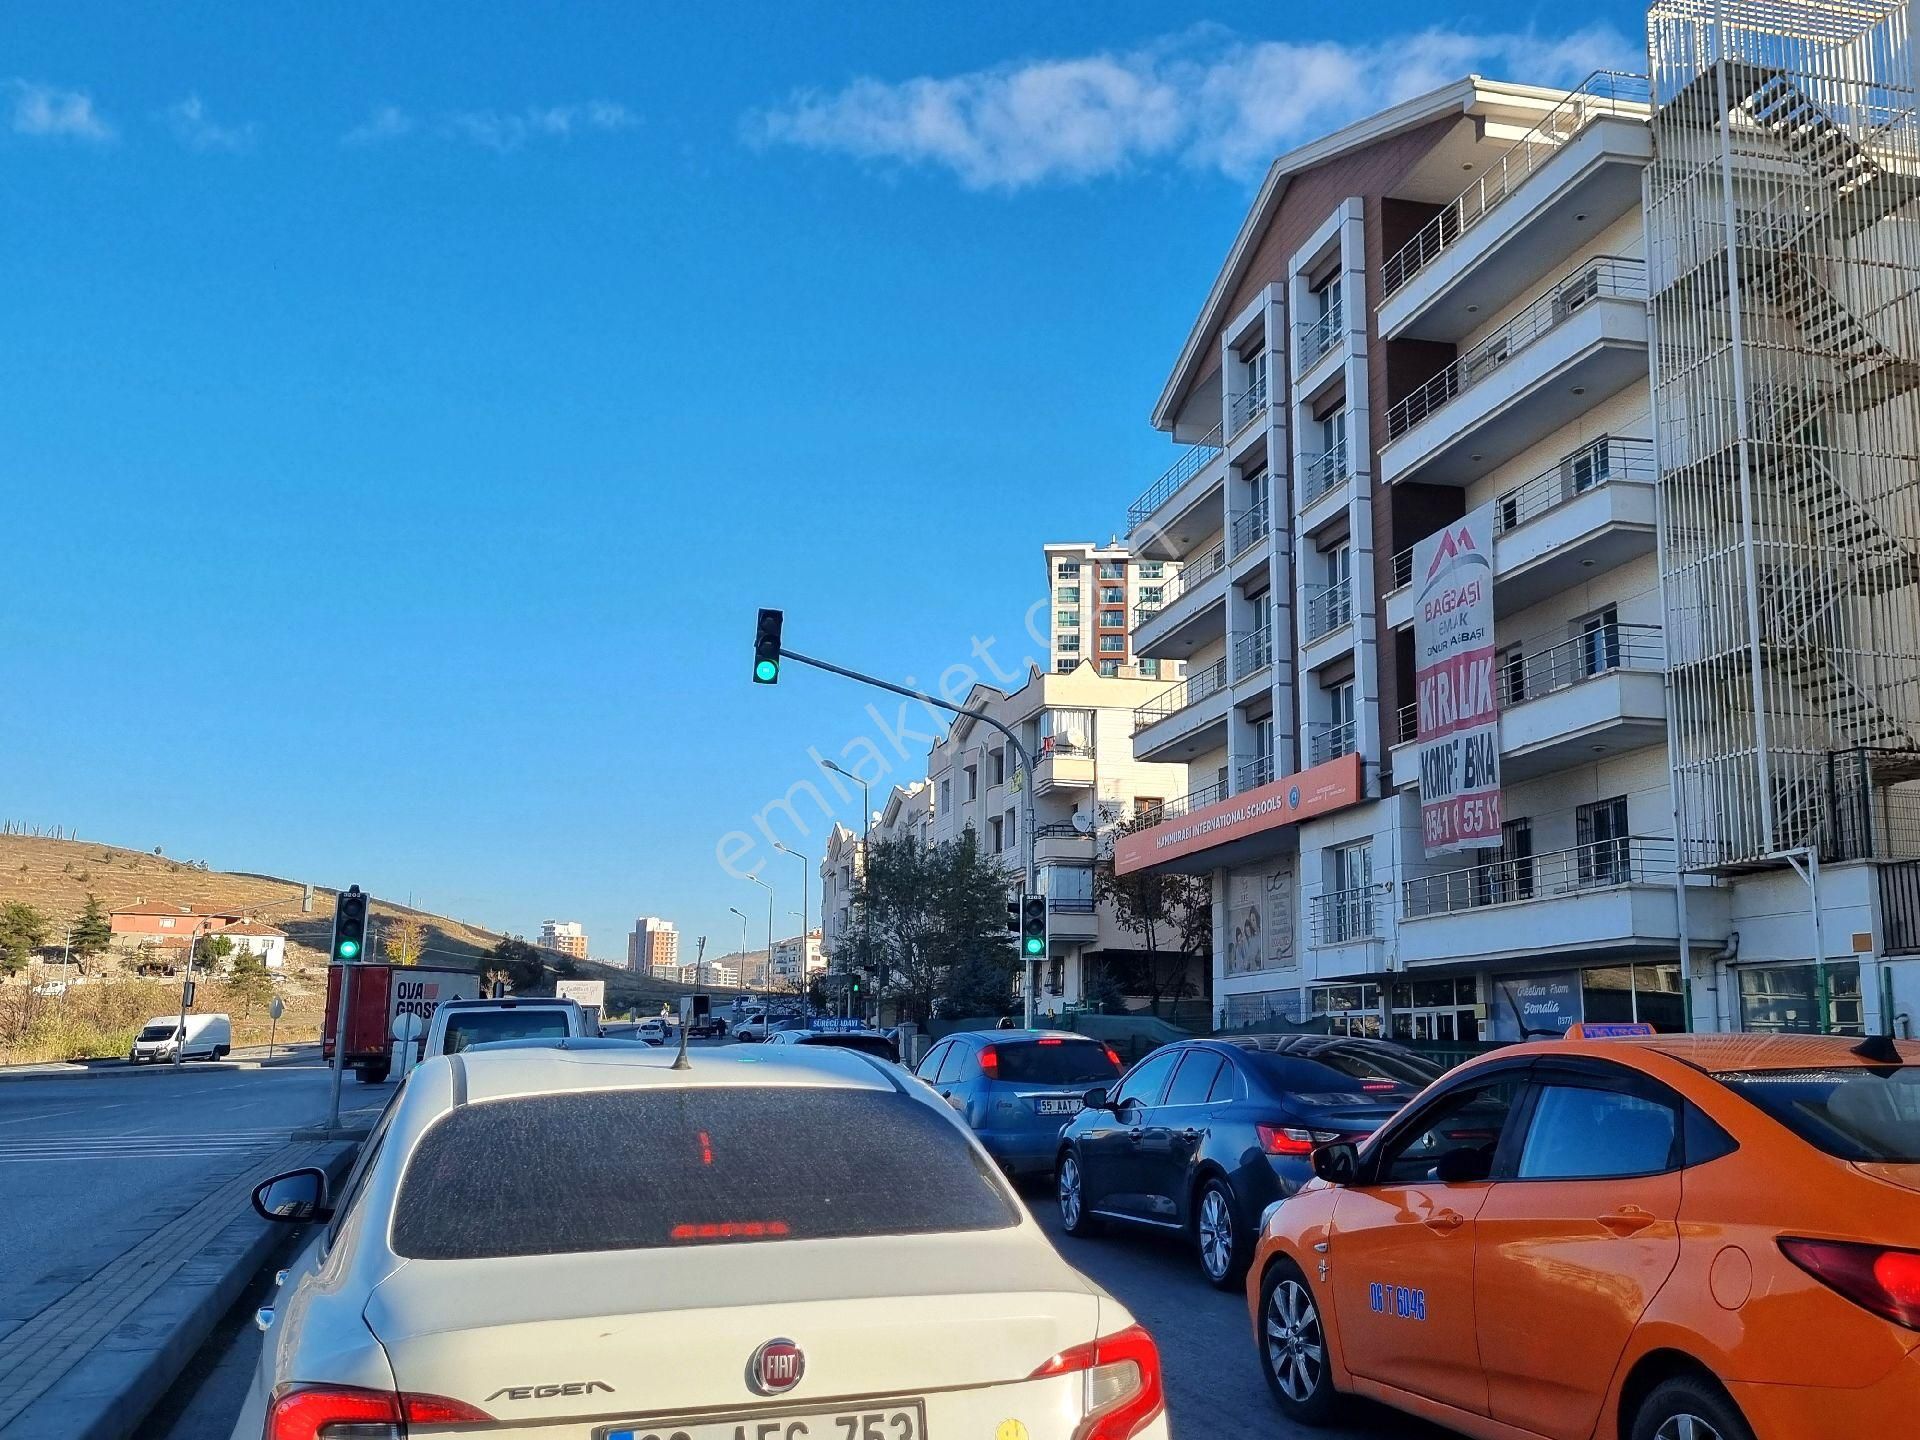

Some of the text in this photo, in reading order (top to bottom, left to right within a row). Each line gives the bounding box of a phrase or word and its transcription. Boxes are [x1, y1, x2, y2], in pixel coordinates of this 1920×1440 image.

[1191, 809, 1246, 837] INTERNATIONAL
[1246, 795, 1283, 819] SCHOOLS
[397, 982, 424, 1000] OVA
[1523, 1001, 1560, 1014] Somalia
[1041, 1100, 1053, 1112] 55
[1057, 1100, 1073, 1112] AAT
[1369, 1282, 1426, 1321] 06 T 6046
[766, 1354, 796, 1380] FIAT
